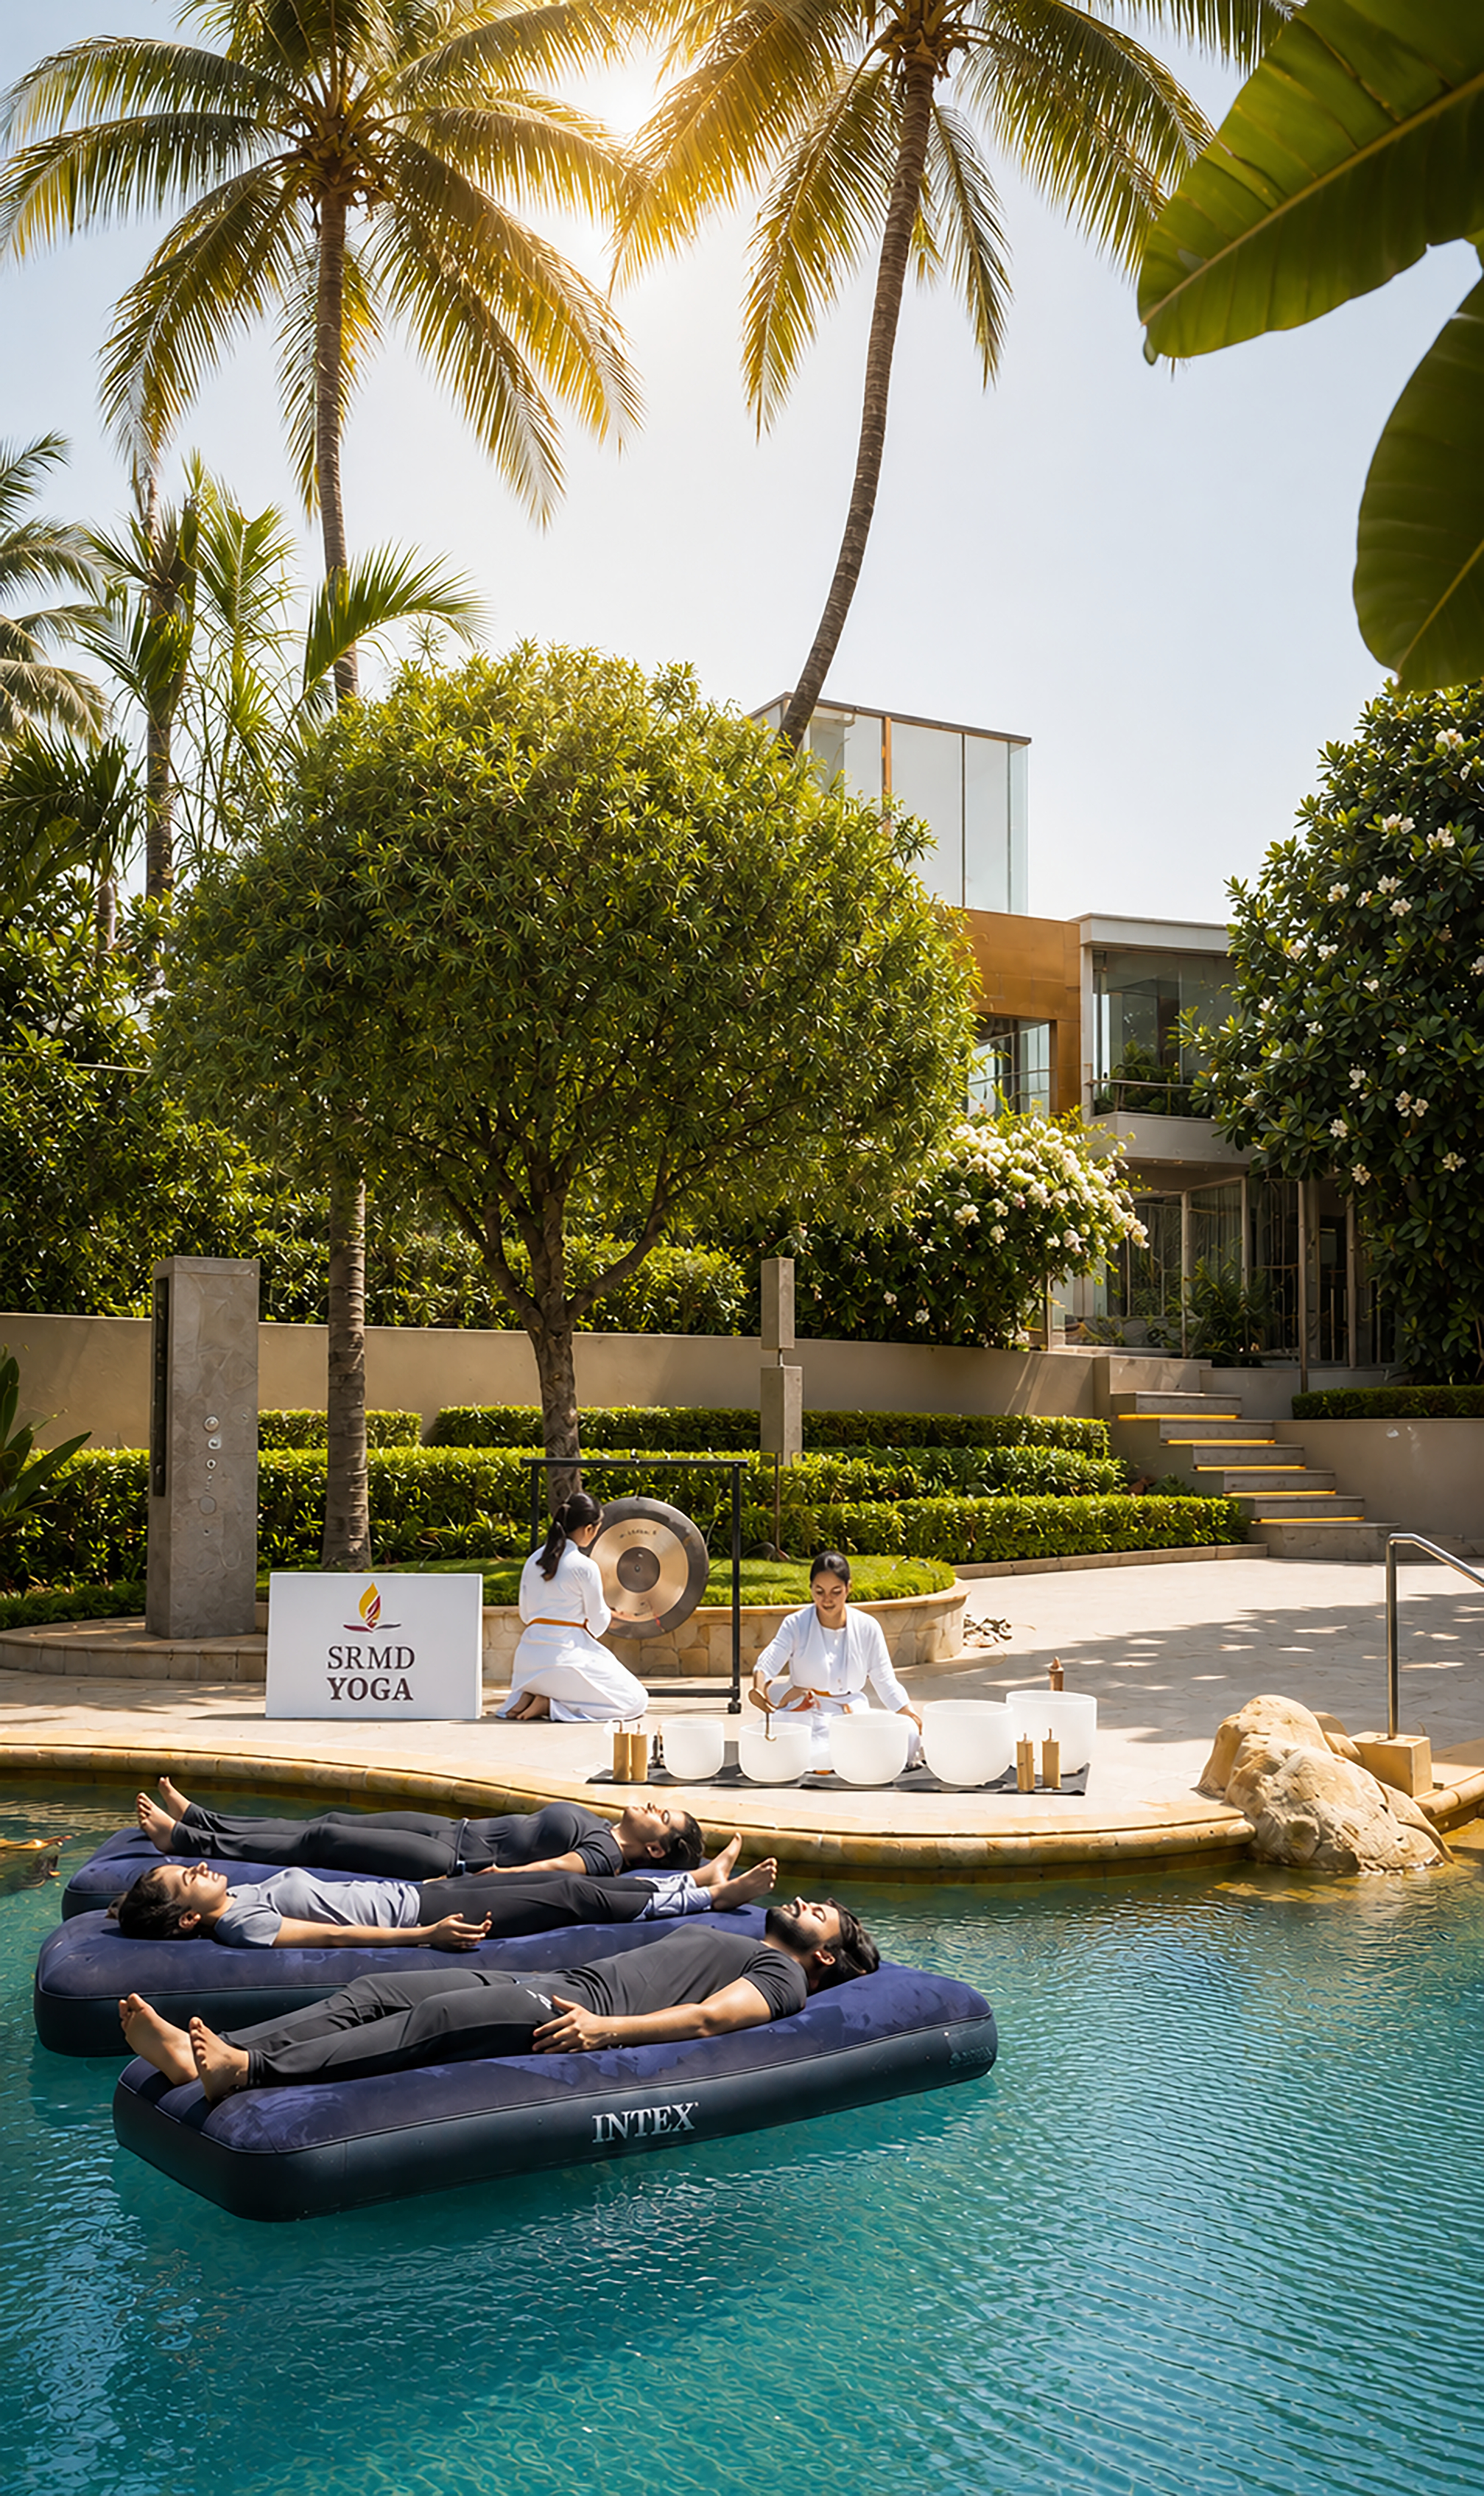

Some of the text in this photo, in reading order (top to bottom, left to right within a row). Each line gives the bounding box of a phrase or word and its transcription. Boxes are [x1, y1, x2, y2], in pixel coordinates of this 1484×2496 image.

[328, 1645, 415, 1669] SRMD
[326, 1677, 414, 1701] YOGA
[591, 2102, 696, 2143] INTEX
